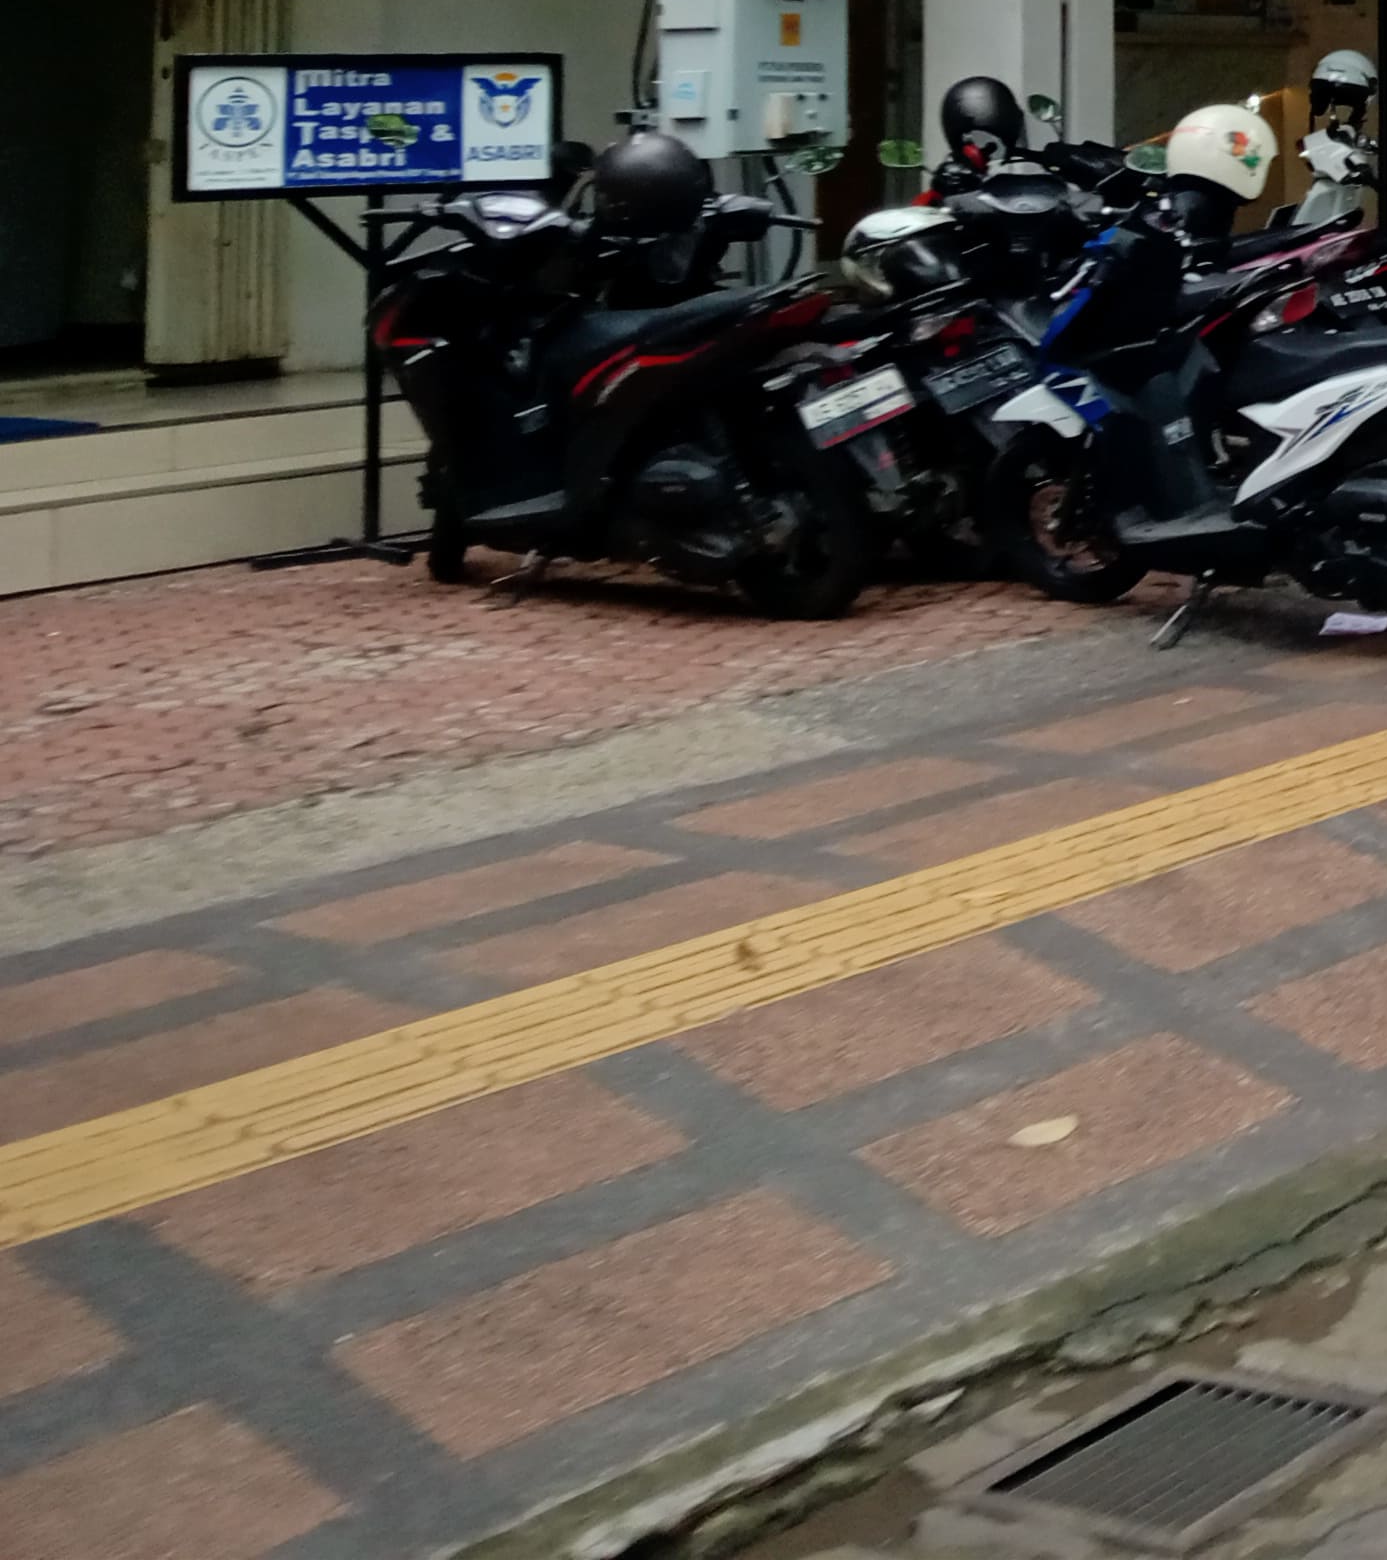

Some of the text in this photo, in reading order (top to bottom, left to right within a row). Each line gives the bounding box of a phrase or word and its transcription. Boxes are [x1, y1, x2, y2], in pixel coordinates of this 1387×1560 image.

[294, 69, 392, 95] Mitra
[293, 98, 446, 121] Layanan
[292, 121, 455, 146] Tasp &
[292, 148, 407, 168] Asabri
[466, 144, 545, 162] ASABRI
